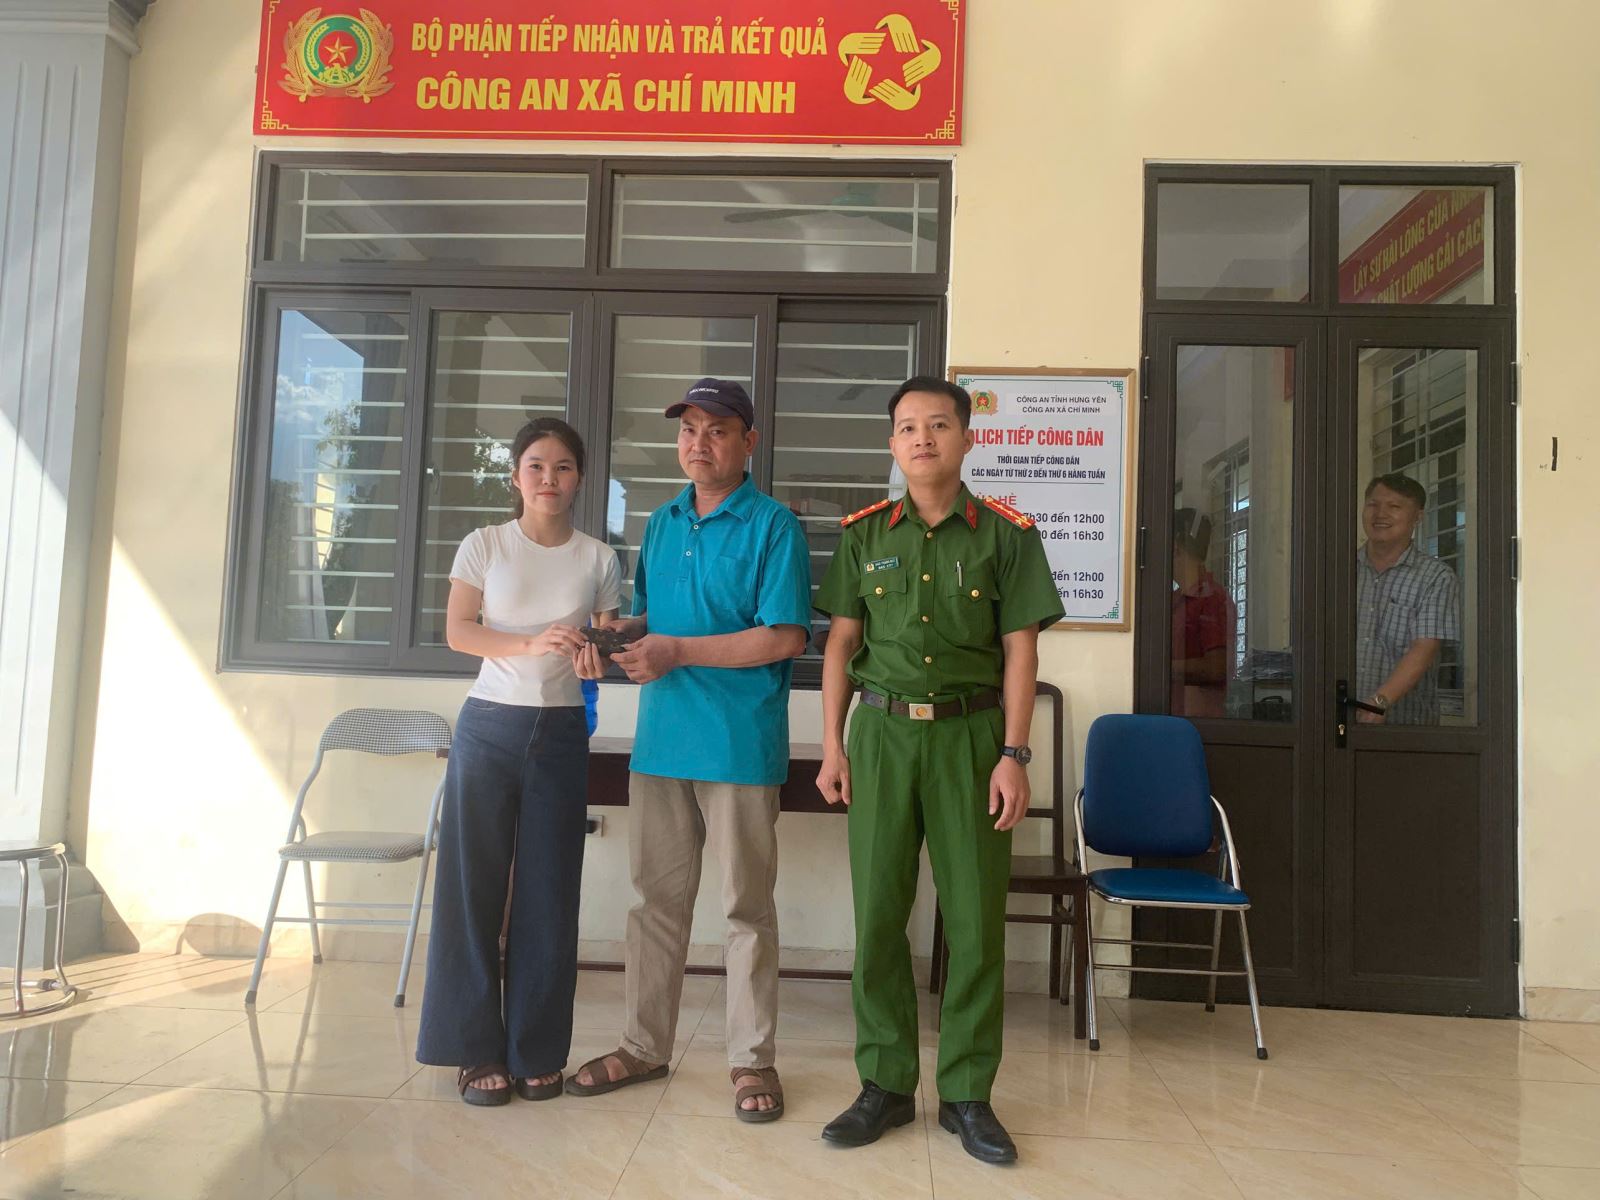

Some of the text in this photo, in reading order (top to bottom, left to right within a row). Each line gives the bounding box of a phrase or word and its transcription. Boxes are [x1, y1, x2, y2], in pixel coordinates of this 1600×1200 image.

[412, 15, 828, 59] BỘ PHẬN TIẾP NHẬN VÀ TRẢ KẾT QUẢ
[416, 70, 796, 113] CÔNG AN XÃ CHÍ MINH
[1400, 217, 1425, 258] LÒNG
[1427, 194, 1449, 235] CỦA
[1402, 254, 1434, 299] LƯỢNG
[1437, 232, 1455, 272] CẢI
[1016, 395, 1037, 403] CÔNG
[1091, 395, 1107, 404] YÊN
[1068, 405, 1081, 413] CHÍ
[1081, 406, 1101, 414] MINH
[975, 424, 1104, 448] LỊCH TIẾP CÔNG DÂN
[997, 454, 1080, 465] THỜI GIAN TIẾP CÔNG DÂN
[971, 466, 985, 477] CÁC
[986, 467, 1004, 477] NGÀY
[1028, 470, 1033, 478] 2
[1033, 467, 1048, 478] ĐẾN
[1062, 471, 1067, 479] 6
[1068, 468, 1087, 479] HÀNG
[999, 492, 1017, 506] HÈ
[1050, 512, 1070, 523] đến
[1073, 514, 1105, 524] 12h00
[1050, 529, 1070, 540] đến
[1073, 531, 1105, 541] 16h30
[1073, 571, 1105, 581] 12h00
[1057, 586, 1104, 599] ến 16h30
